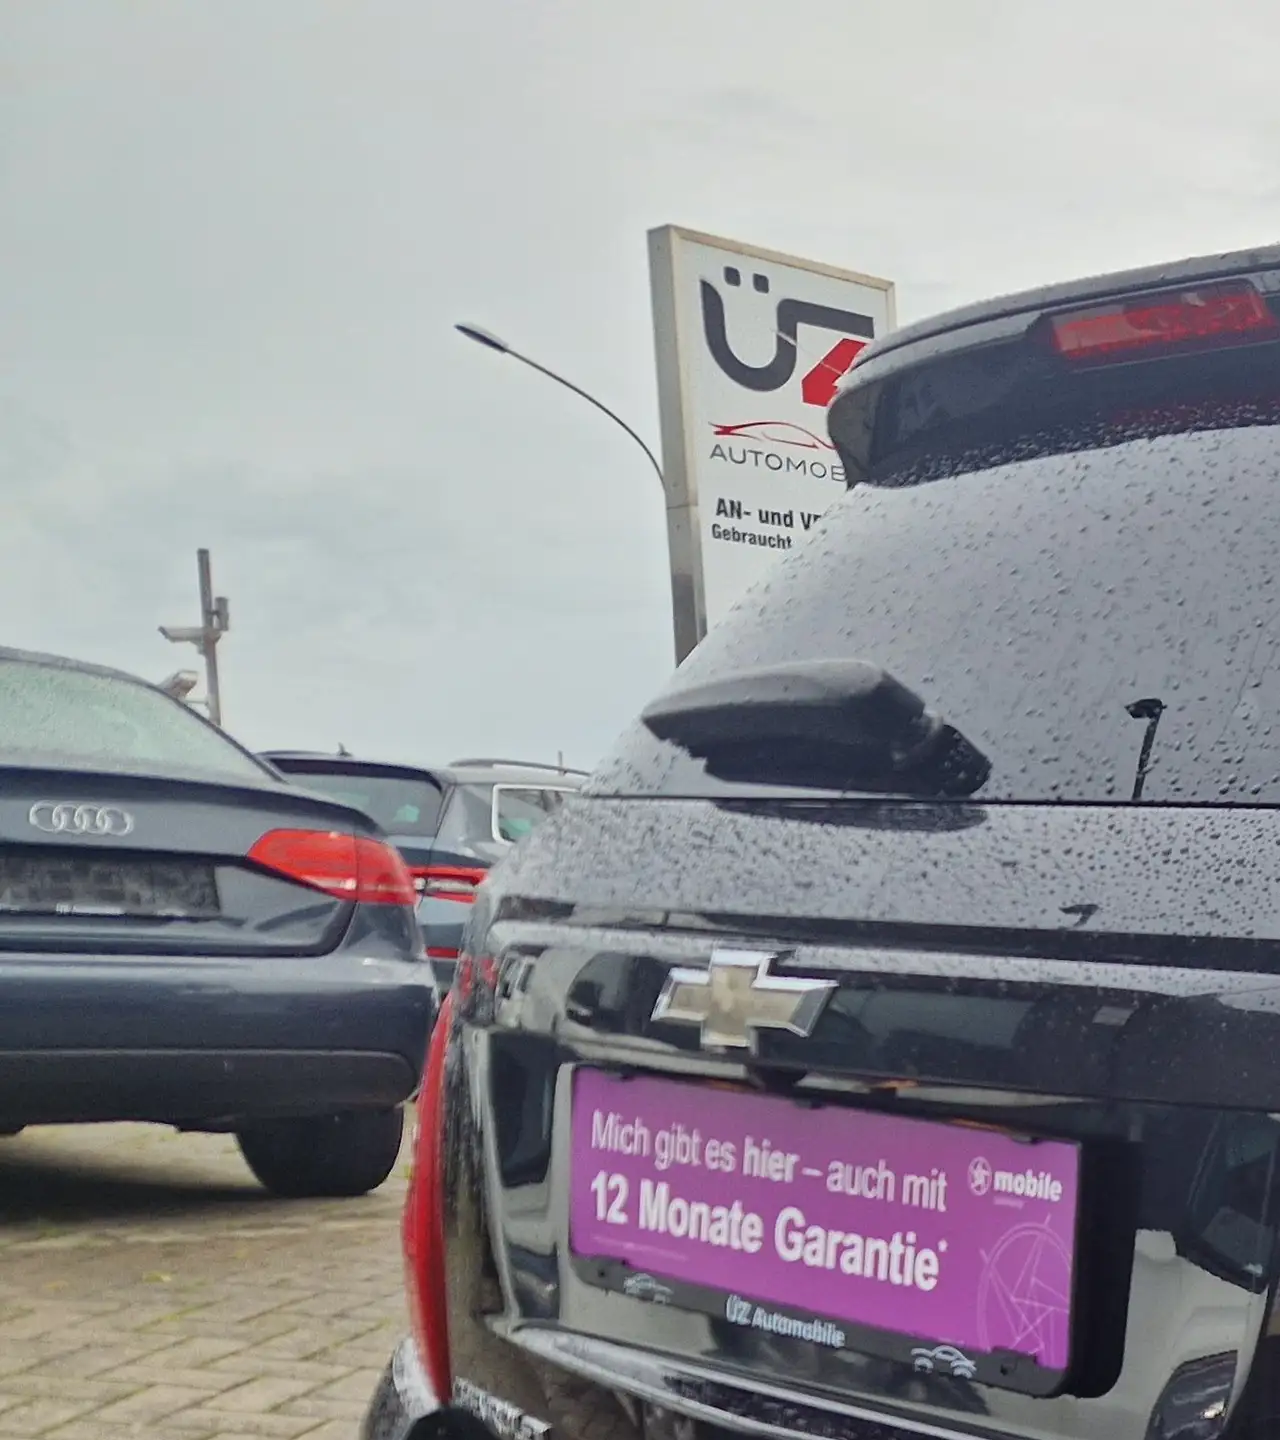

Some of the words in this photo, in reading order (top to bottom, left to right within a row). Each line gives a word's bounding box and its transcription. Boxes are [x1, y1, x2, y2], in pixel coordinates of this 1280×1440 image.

[715, 497, 752, 520] AN-
[758, 507, 794, 529] und
[591, 1108, 651, 1157] Mich
[654, 1121, 703, 1171] gibt
[705, 1137, 737, 1173] es
[742, 1135, 801, 1184] hier
[826, 1159, 896, 1202] auch
[902, 1167, 949, 1213] mit
[993, 1168, 1063, 1202] mobile
[590, 1169, 630, 1226] 12
[638, 1177, 765, 1254] Monate
